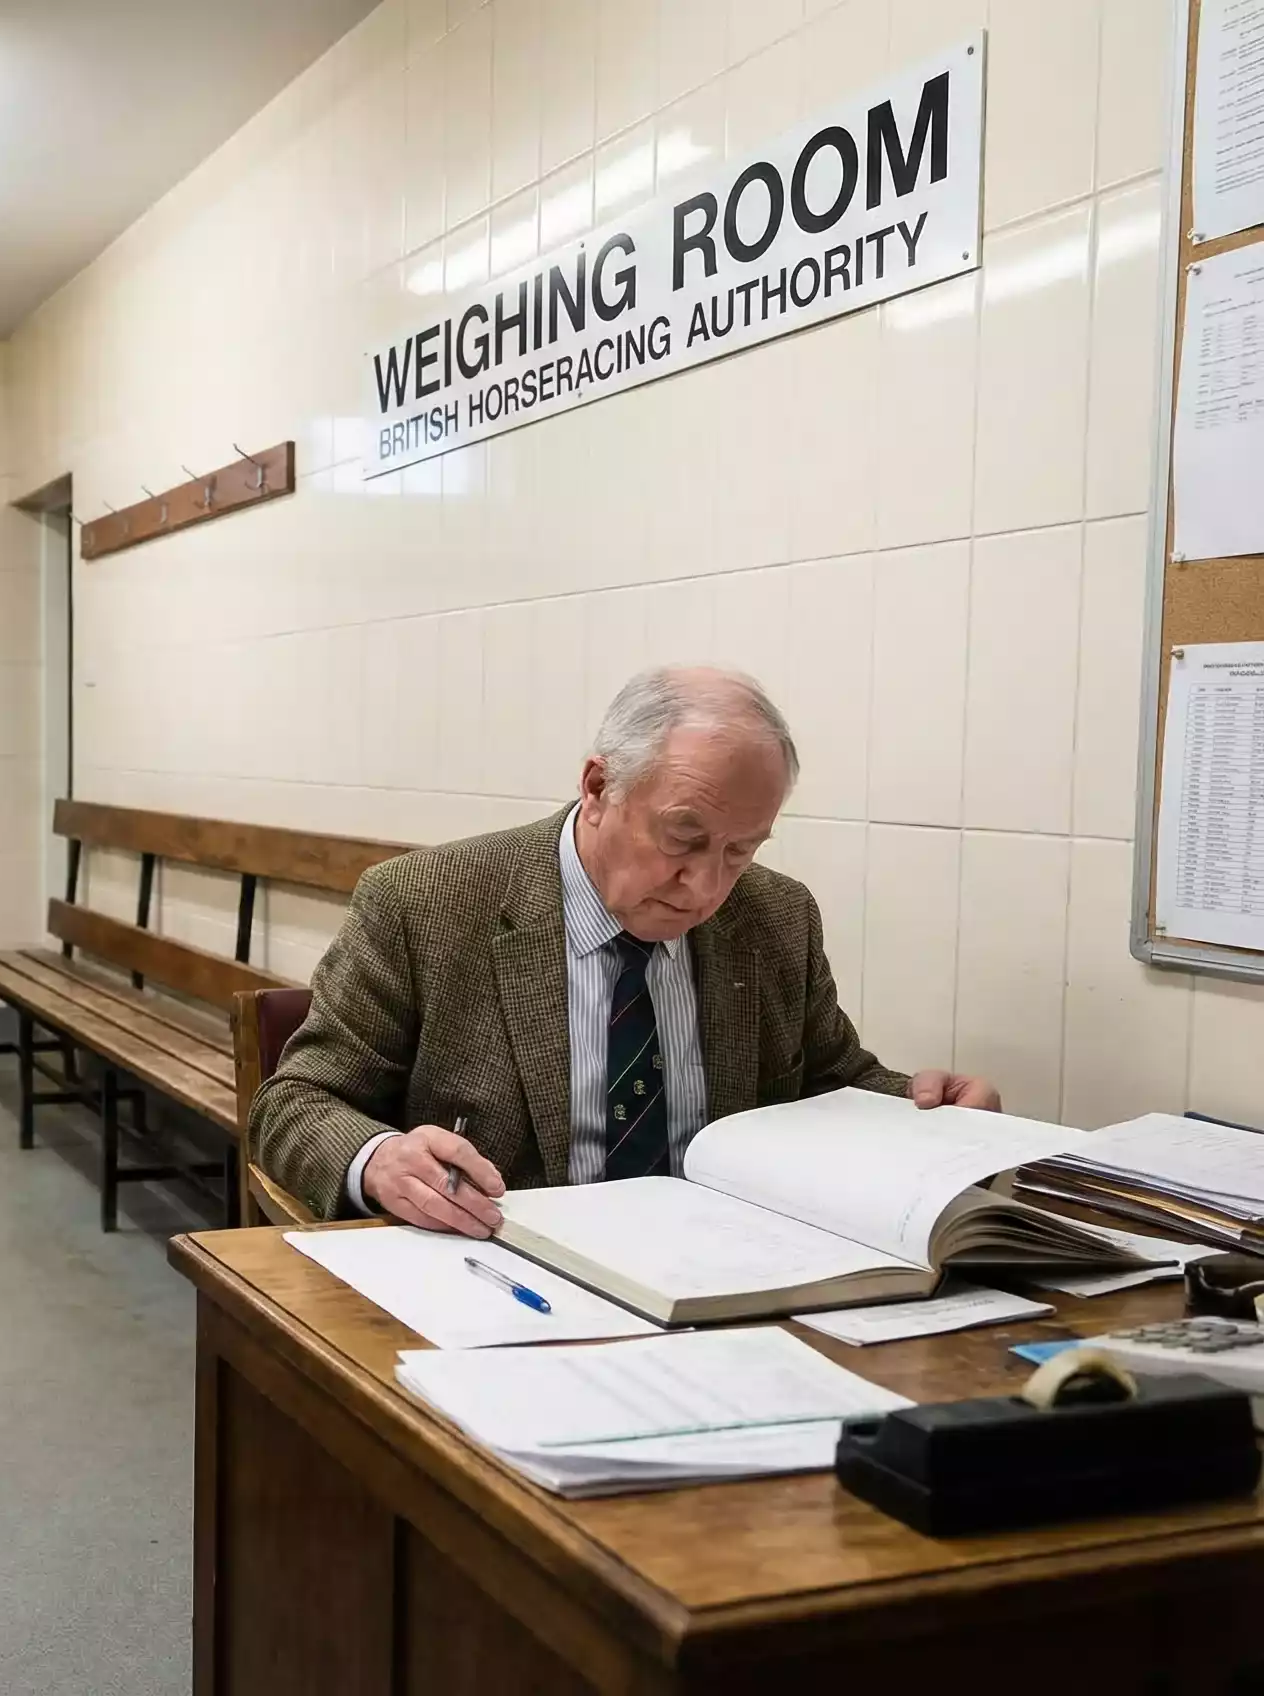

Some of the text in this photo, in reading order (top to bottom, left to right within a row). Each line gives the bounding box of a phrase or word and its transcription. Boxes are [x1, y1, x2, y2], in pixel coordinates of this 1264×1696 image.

[373, 71, 950, 414] WEIGHING ROOM
[378, 212, 929, 459] BRITISH HORSERACING AUTHORITY
